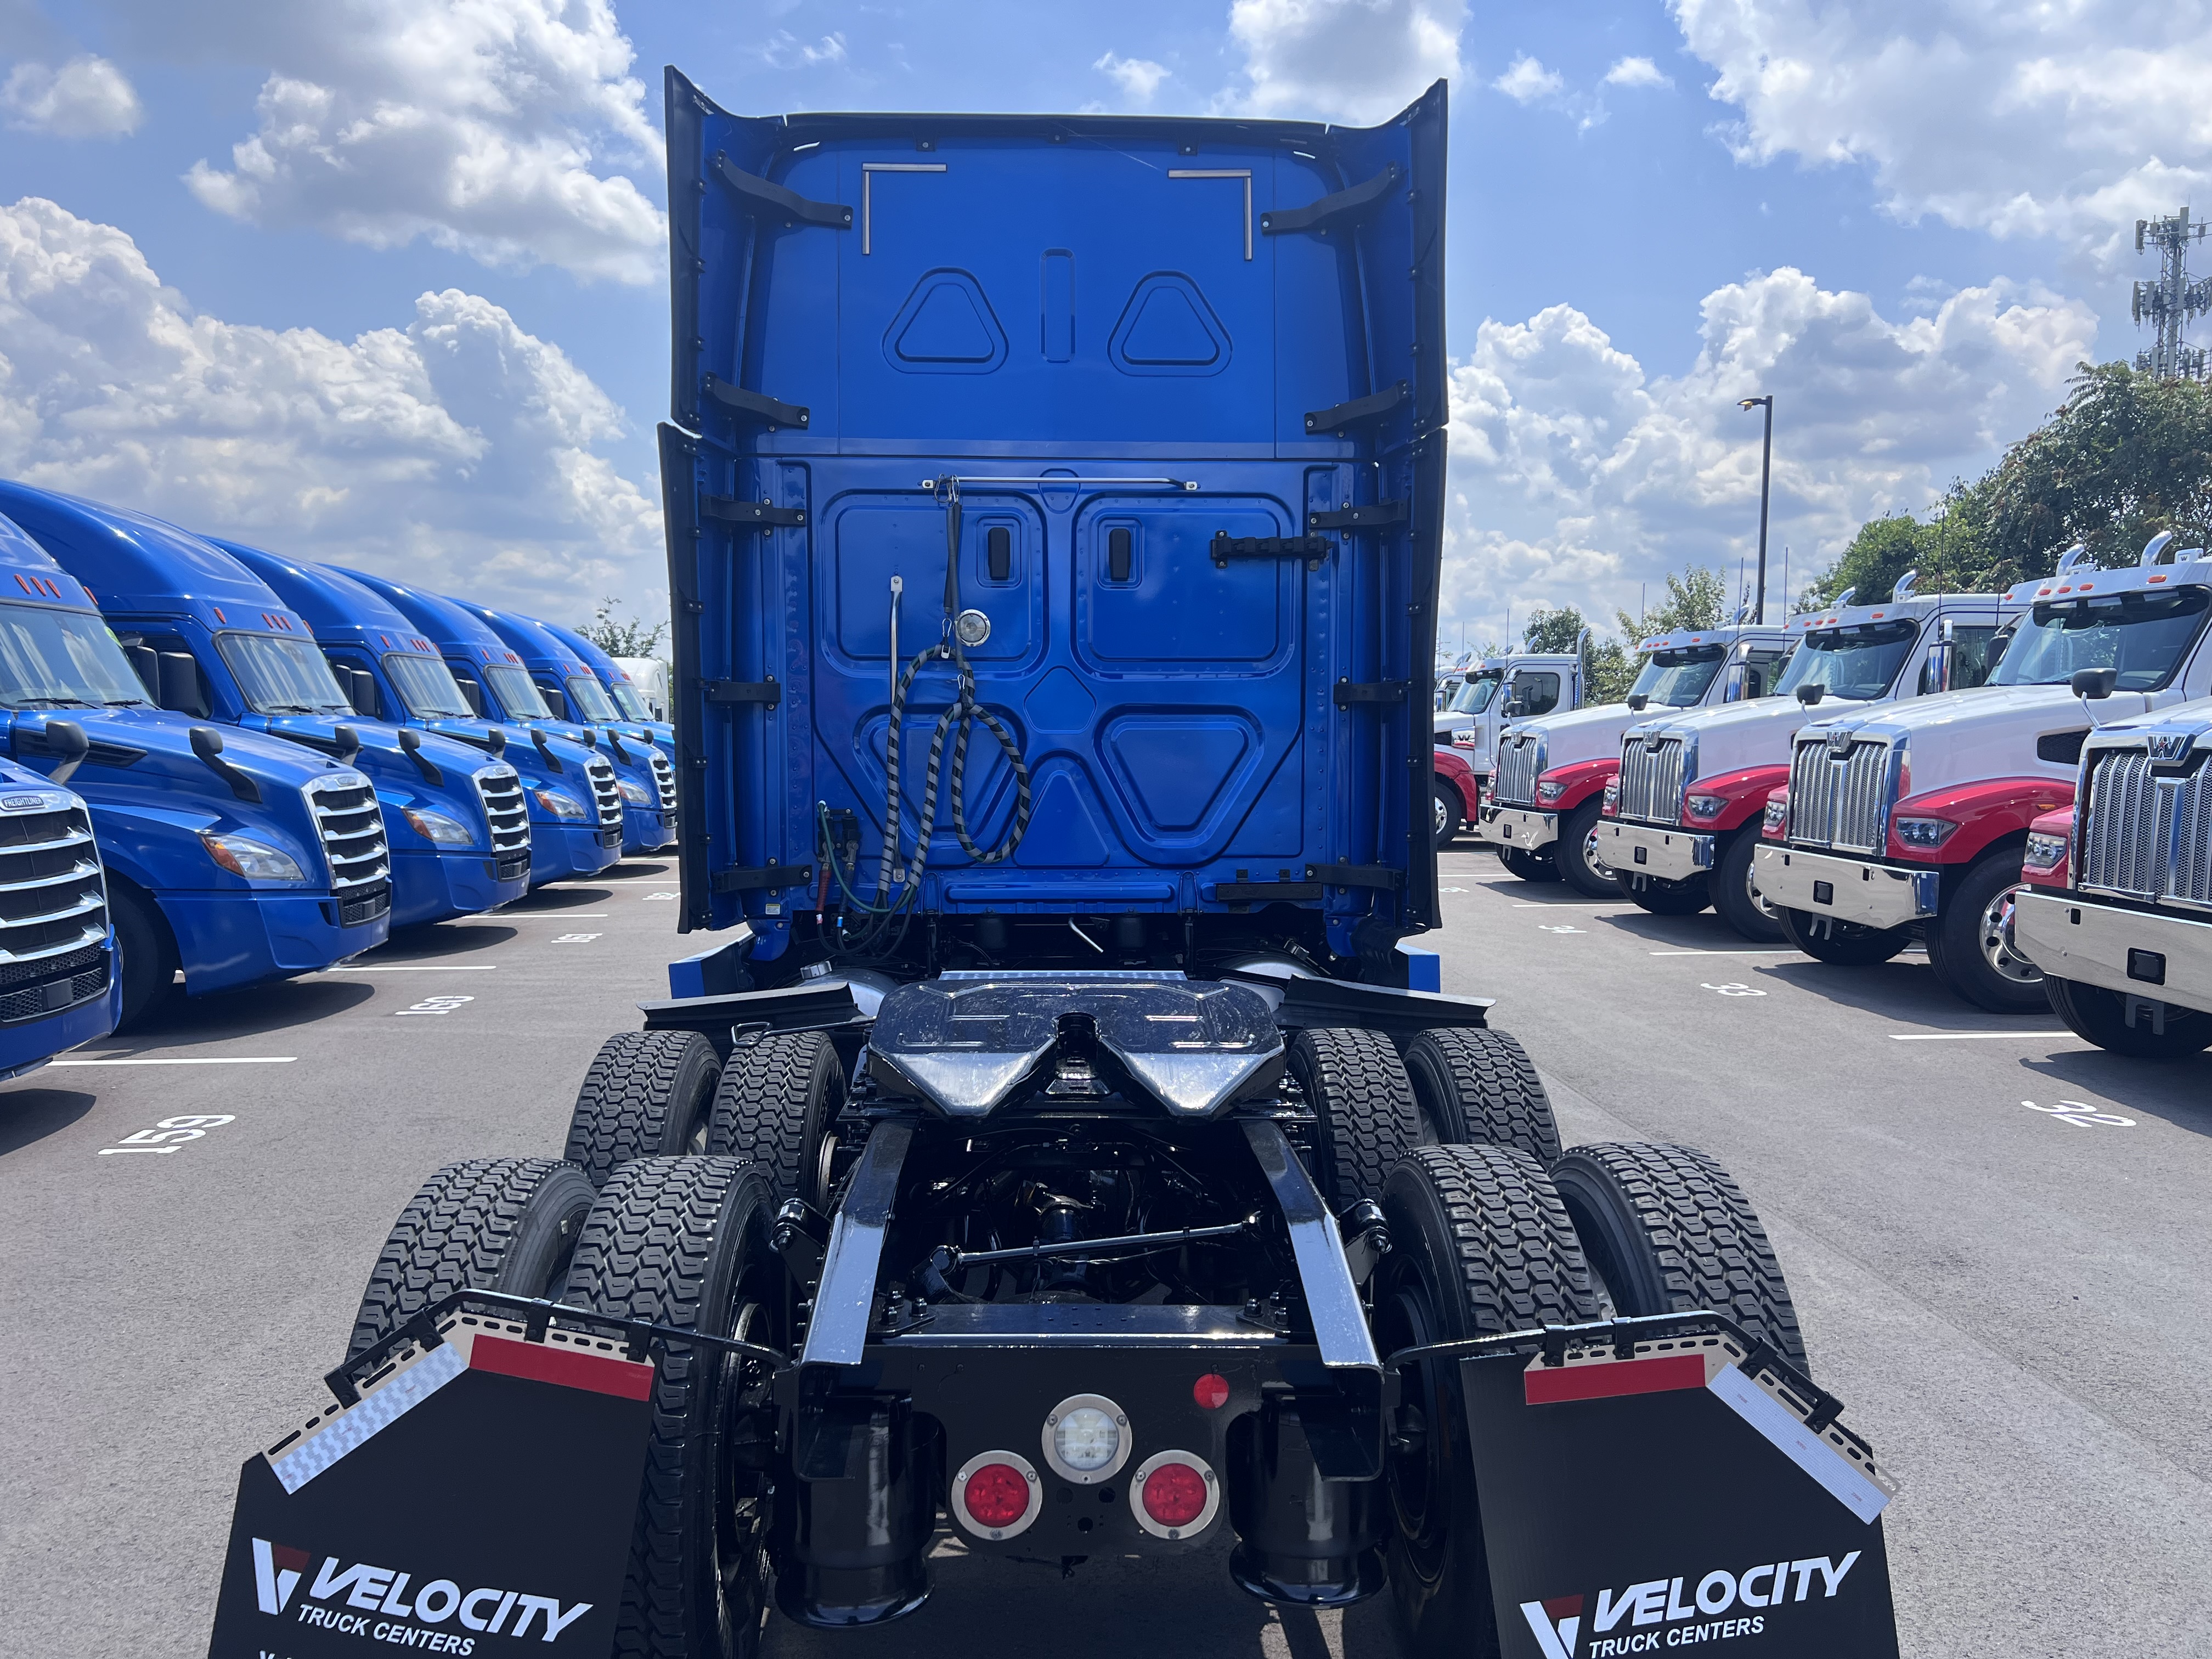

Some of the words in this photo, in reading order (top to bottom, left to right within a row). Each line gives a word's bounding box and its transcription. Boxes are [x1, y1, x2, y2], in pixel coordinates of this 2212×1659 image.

[4, 797, 43, 808] FREIGHTLINER
[395, 996, 475, 1015] 160
[1701, 983, 1767, 996] 33
[2021, 1100, 2137, 1127] 32
[98, 1114, 236, 1155] 159
[309, 1556, 594, 1642] VELOCITY
[1593, 1550, 1862, 1632] VELOCITY
[298, 1604, 371, 1637] TRUCK
[374, 1622, 476, 1656] CENTERS
[1589, 1631, 1661, 1659] TRUCK
[1667, 1616, 1764, 1647] CENTERS
